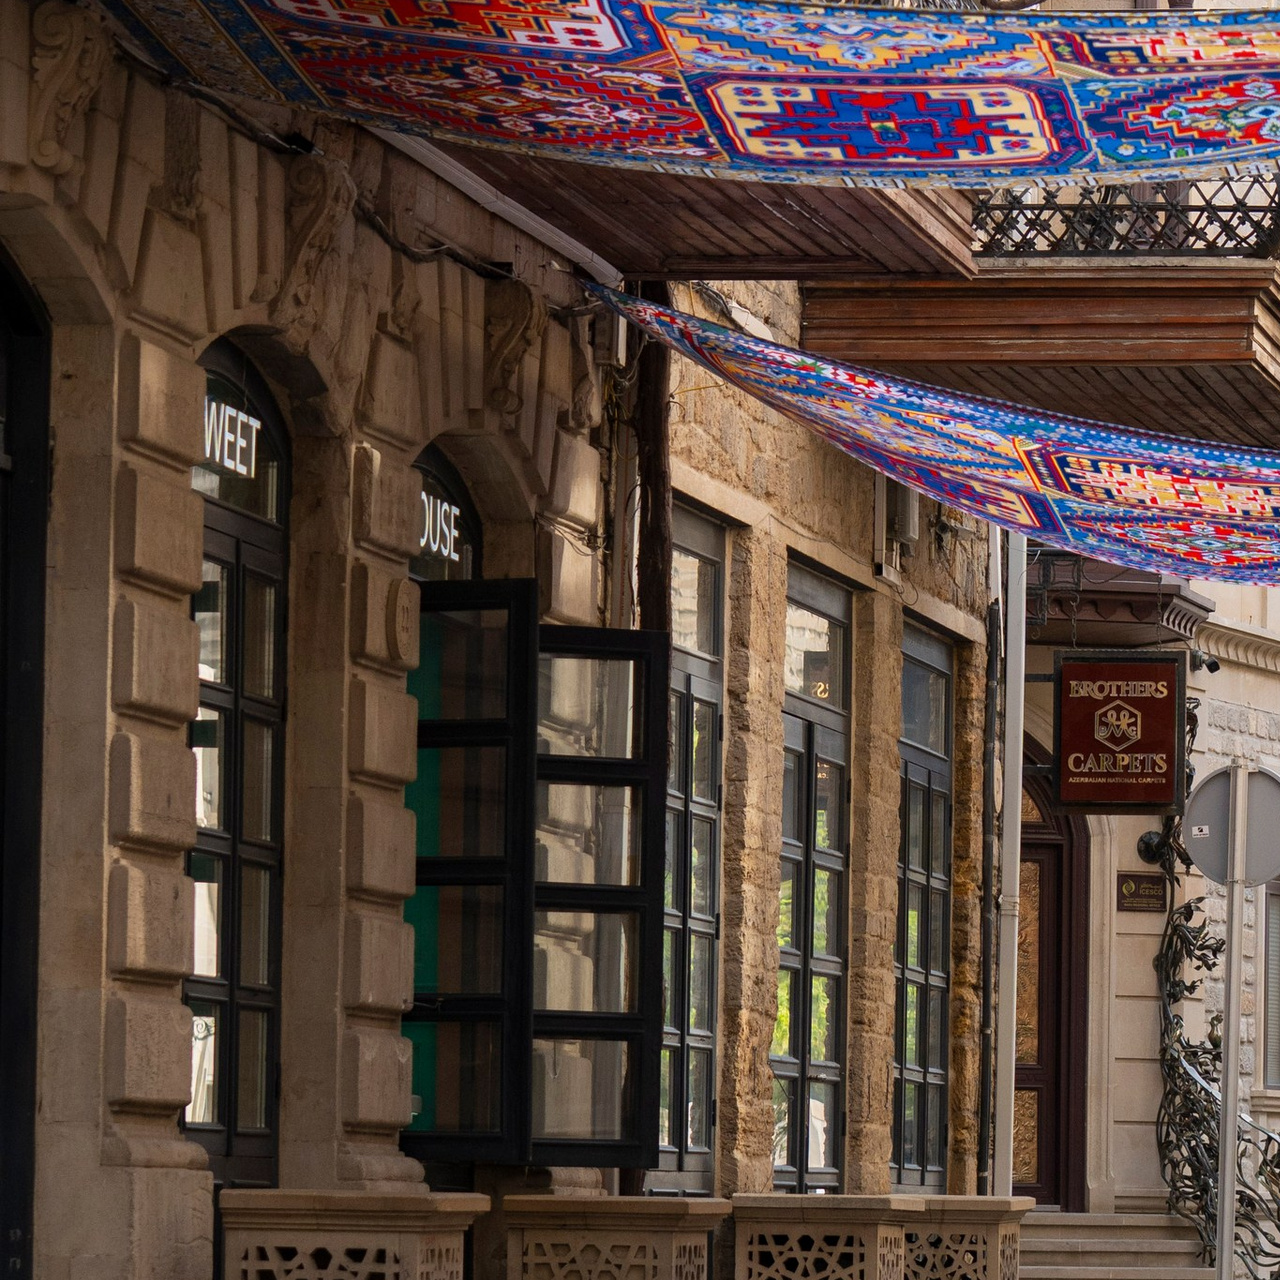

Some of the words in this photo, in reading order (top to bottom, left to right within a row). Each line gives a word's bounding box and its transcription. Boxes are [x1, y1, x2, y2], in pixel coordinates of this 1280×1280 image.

[204, 396, 261, 478] WEET
[420, 491, 460, 561] OUSE
[1069, 680, 1168, 700] BROTHERS
[1067, 753, 1167, 773] CARPETS
